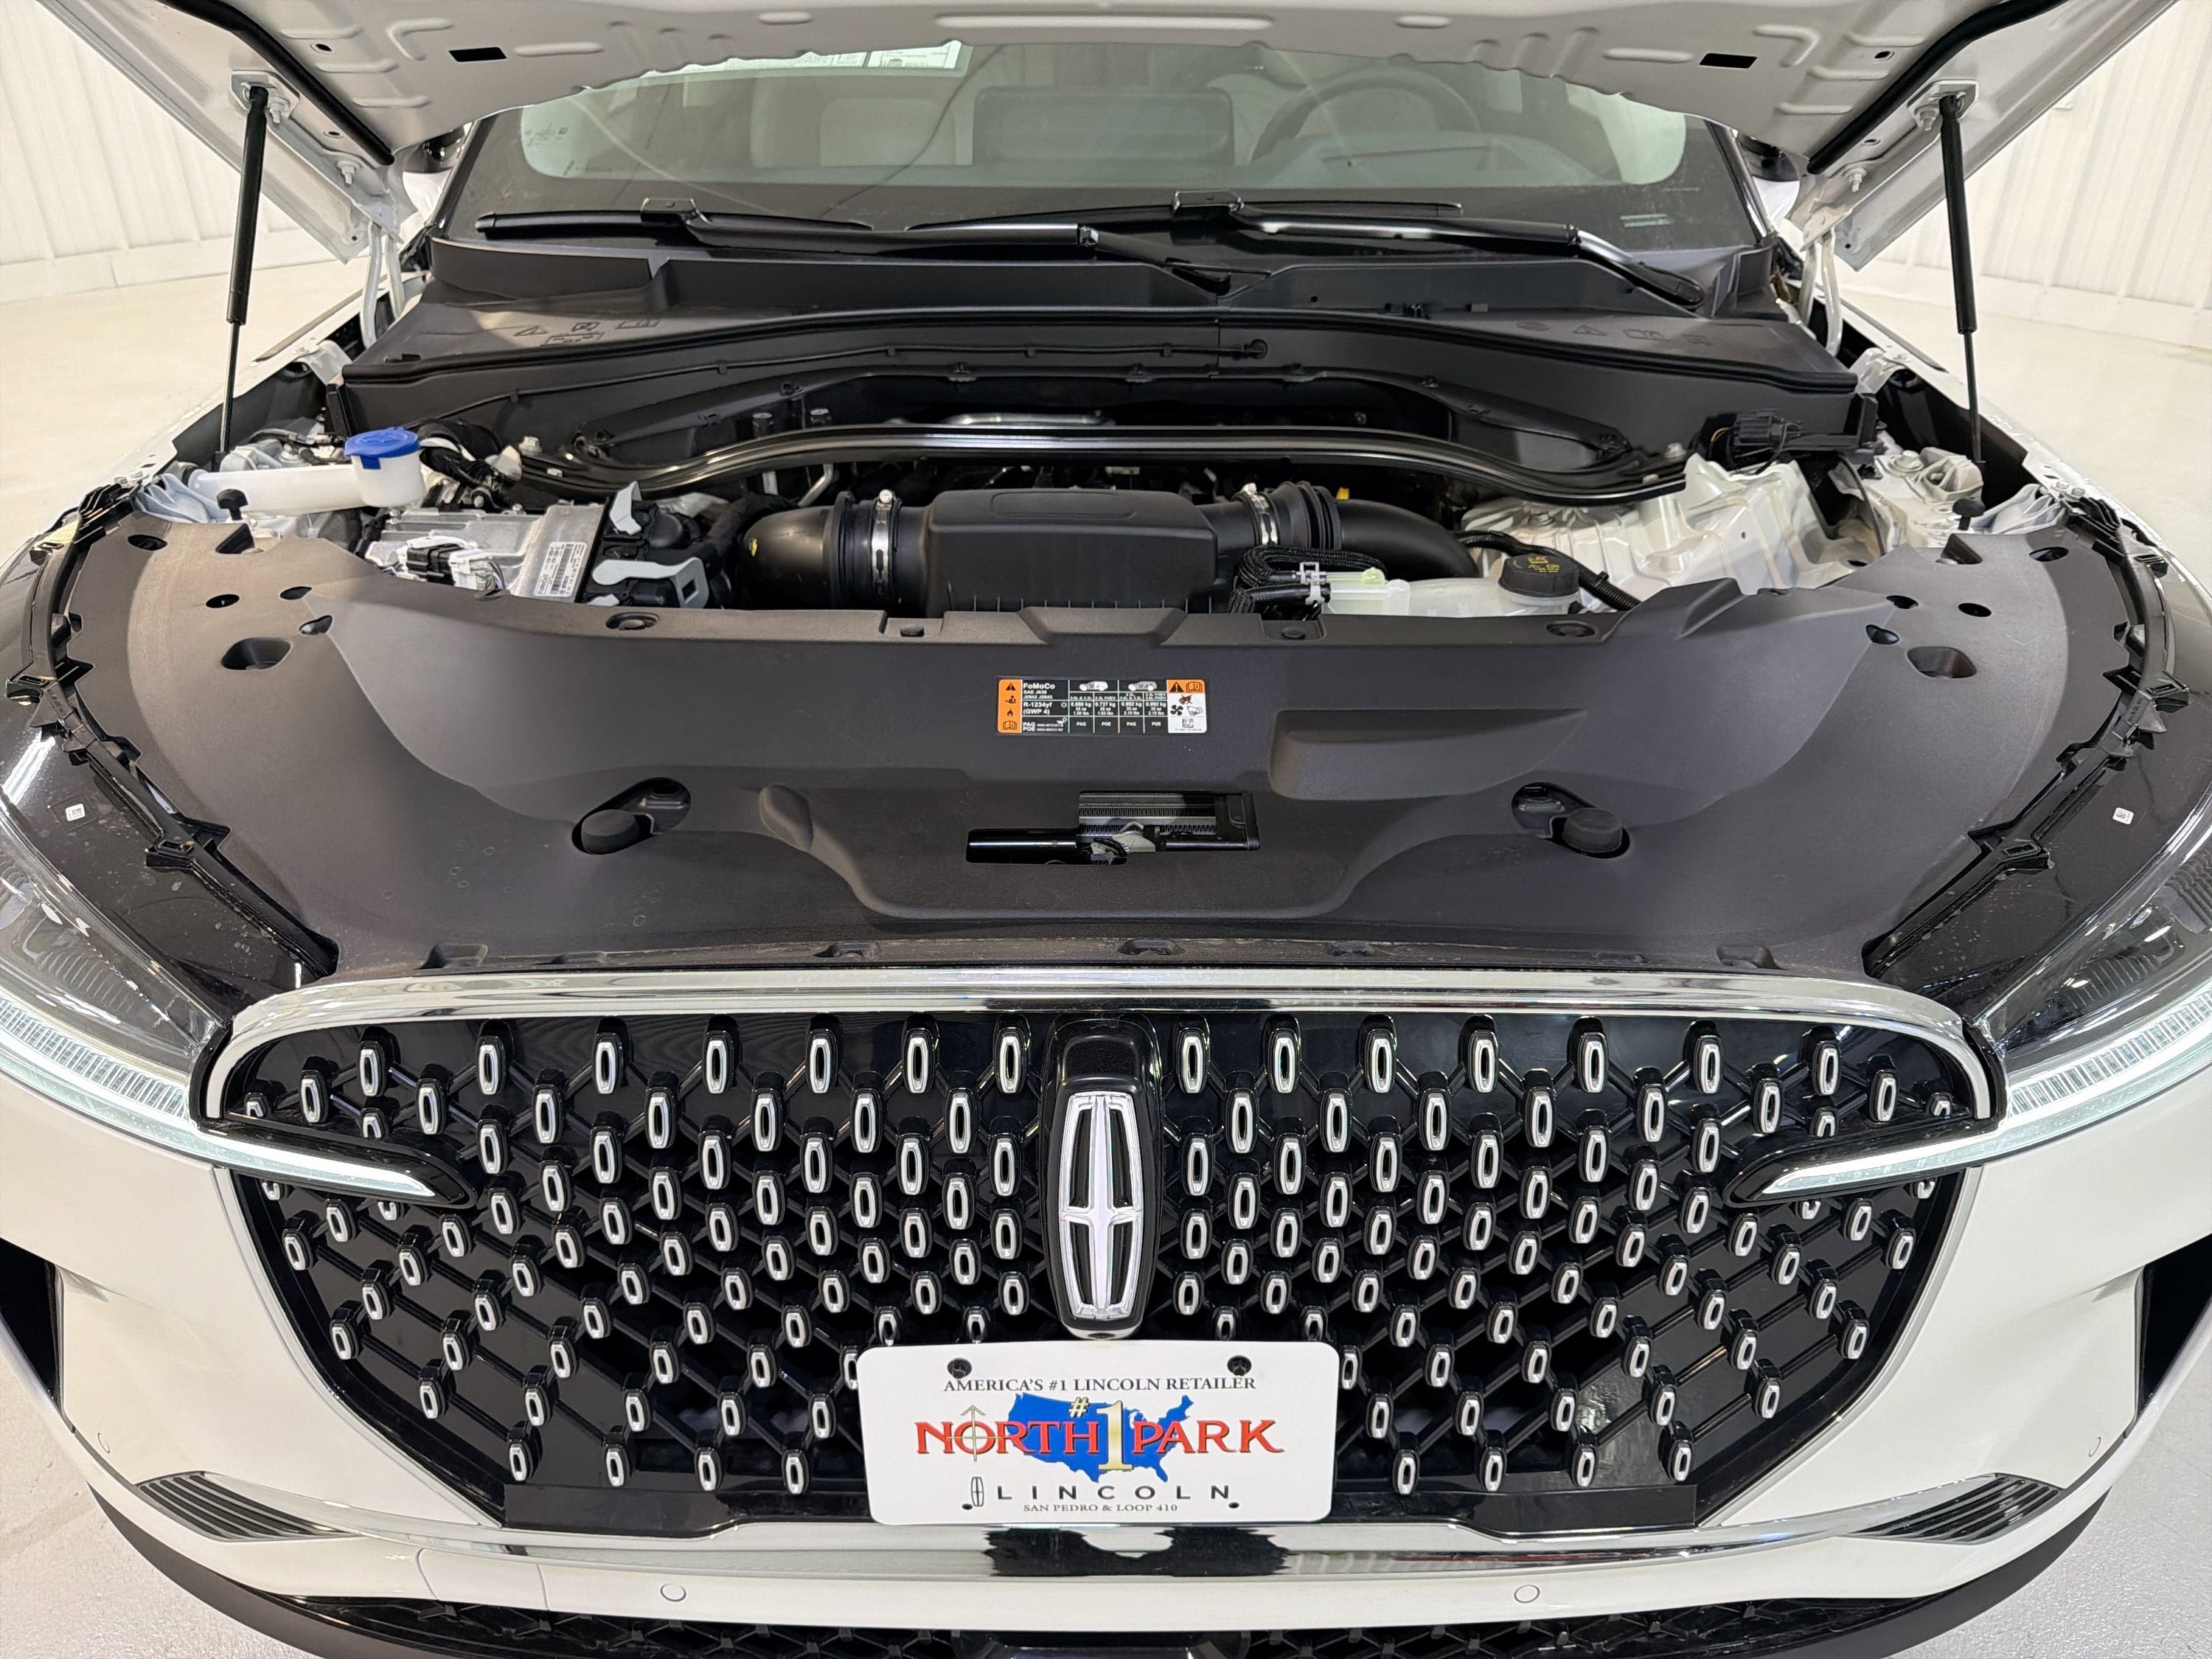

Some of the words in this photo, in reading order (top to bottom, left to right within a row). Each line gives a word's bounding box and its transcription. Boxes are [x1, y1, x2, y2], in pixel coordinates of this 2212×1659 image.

[943, 1379, 1043, 1391] AMERICA'S
[1048, 1380, 1068, 1391] #1
[1074, 1378, 1161, 1391] LINCOLN
[1165, 1377, 1256, 1390] RETAILER
[914, 1421, 1099, 1455] NORTH
[1131, 1419, 1285, 1454] PARK
[997, 1485, 1229, 1500] LINCOLN
[1023, 1503, 1051, 1512] SAN
[1054, 1503, 1099, 1512] PEDRO
[1102, 1503, 1113, 1512] &
[1117, 1503, 1152, 1512] LOOP
[1156, 1503, 1178, 1512] 410
